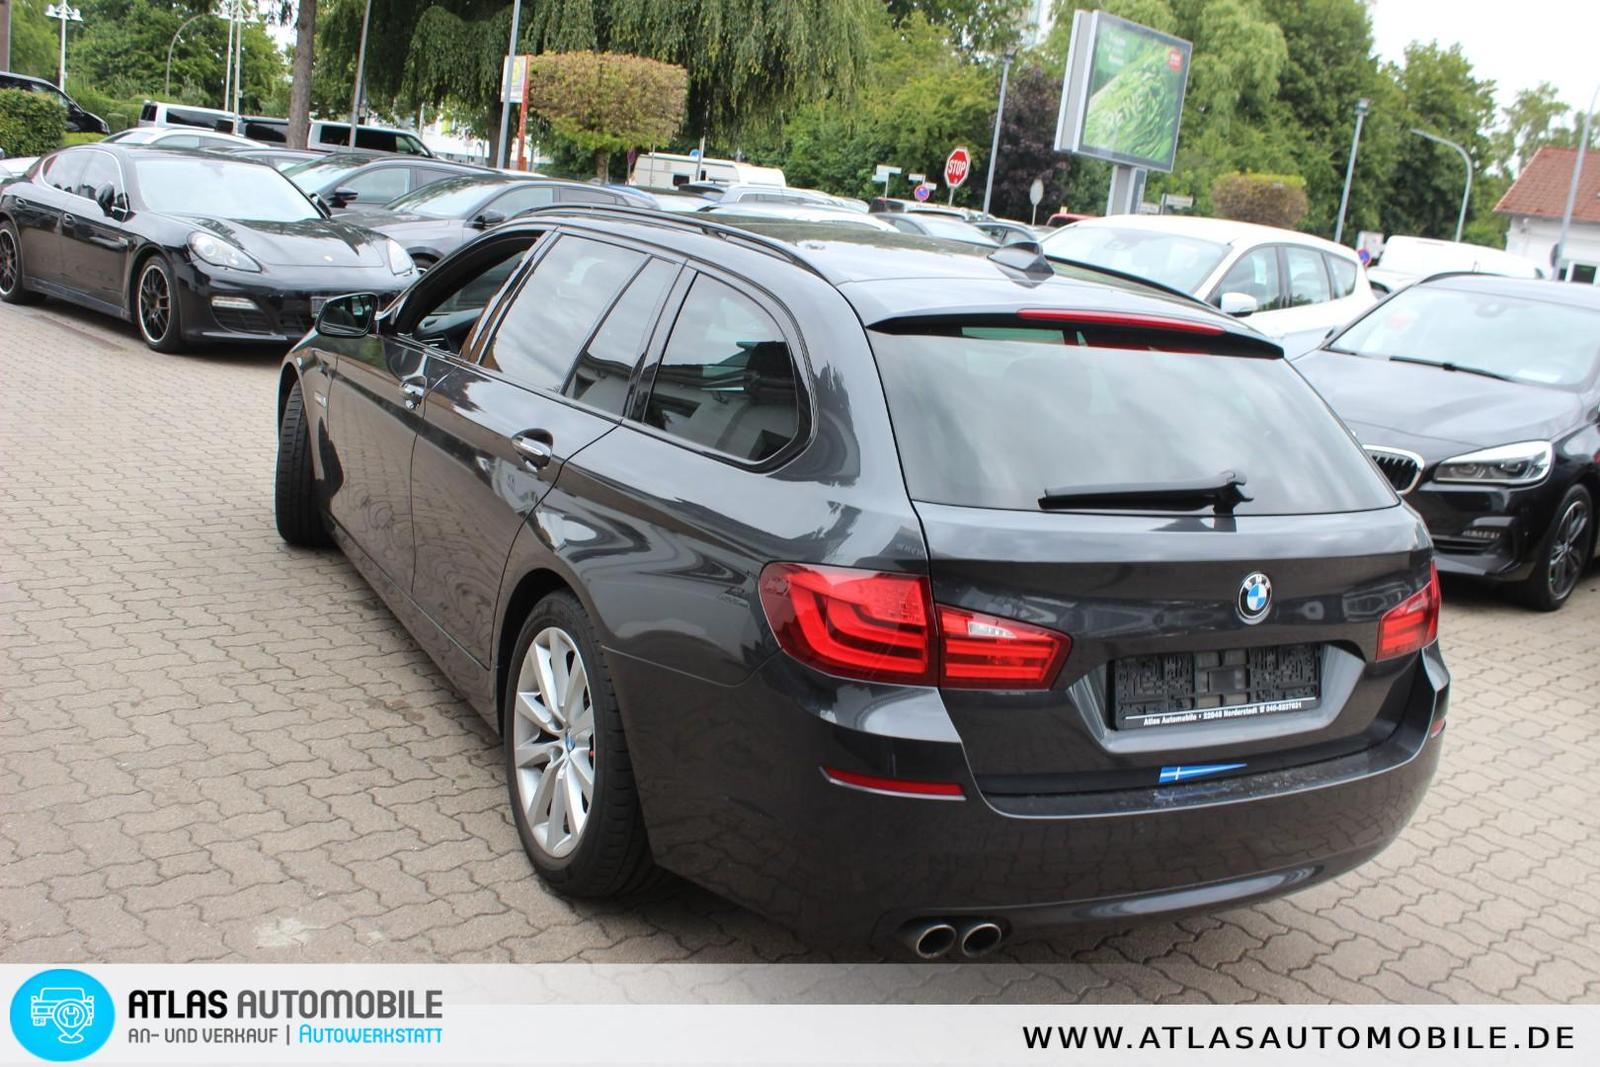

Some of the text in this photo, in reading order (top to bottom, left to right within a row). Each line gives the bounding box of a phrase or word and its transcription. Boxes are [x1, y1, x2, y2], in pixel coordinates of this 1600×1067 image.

[949, 159, 966, 176] STOP
[1143, 717, 1160, 726] Atlas
[1161, 713, 1197, 724] Automobile
